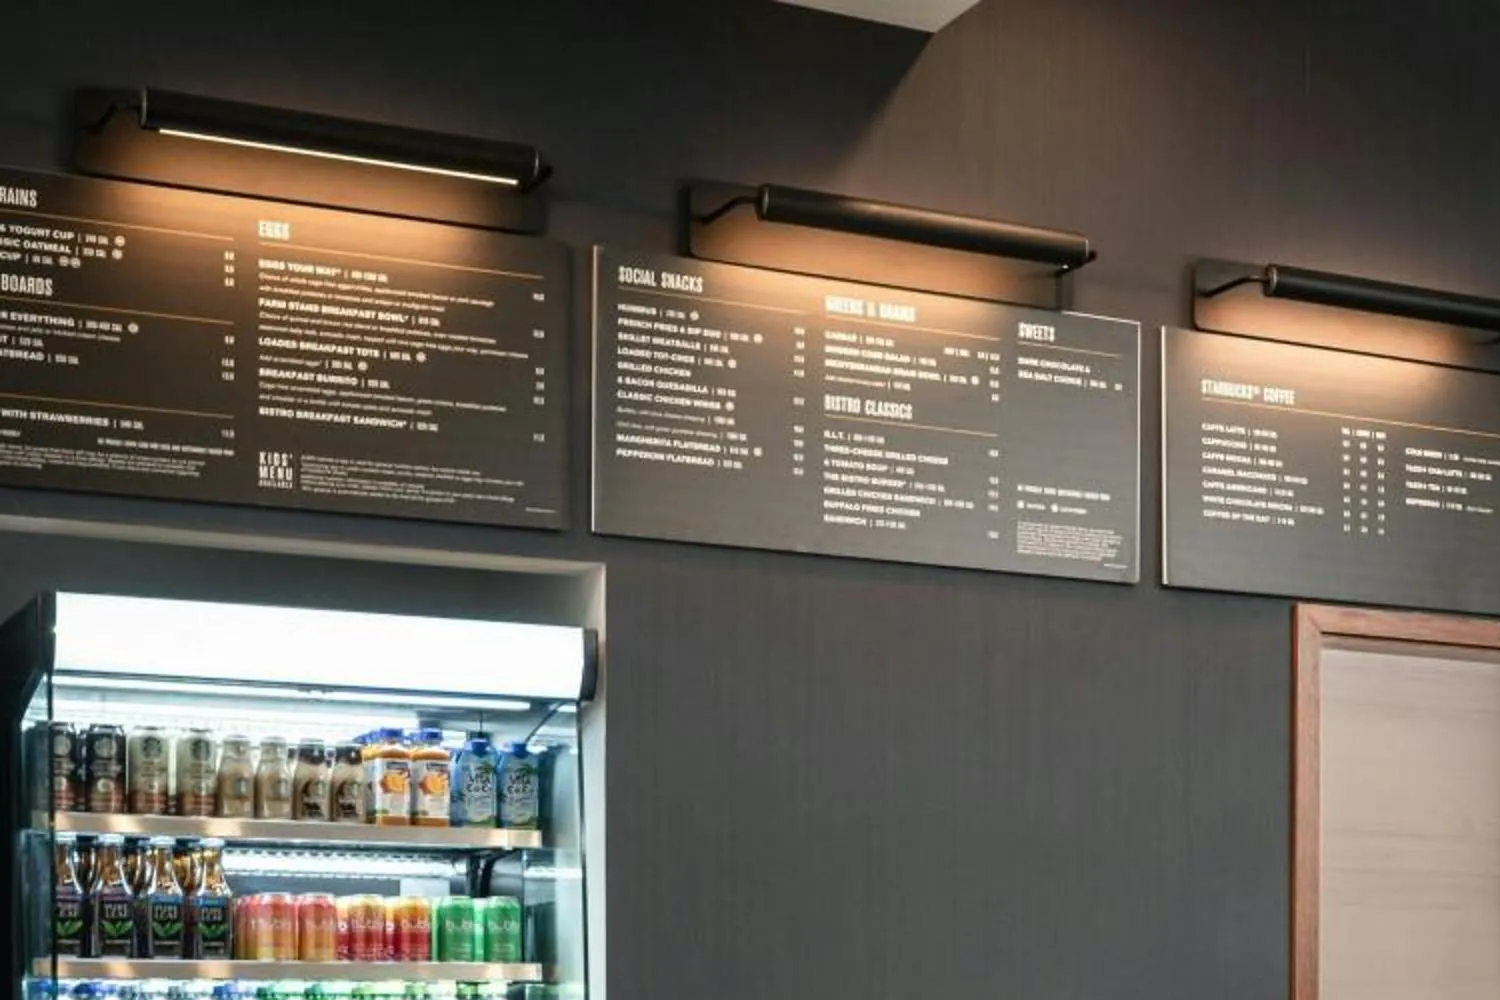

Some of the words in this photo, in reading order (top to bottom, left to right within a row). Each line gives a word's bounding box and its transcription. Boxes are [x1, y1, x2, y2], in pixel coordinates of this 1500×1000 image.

[9, 225, 51, 238] YOGURT
[52, 230, 75, 240] CUP
[23, 240, 72, 254] OATMEAL
[1, 274, 53, 297] BOARDS
[618, 266, 658, 287] SOCIAL
[660, 271, 704, 293] SNACKS
[321, 305, 377, 319] BREAKFAST
[10, 313, 75, 327] EVERYTHING
[618, 318, 653, 330] FRENCH
[1018, 322, 1056, 342] SWEETS
[259, 337, 299, 349] LOADED
[300, 341, 355, 355] BREAKFAST
[652, 337, 701, 351] MEATBALLS
[618, 346, 653, 359] LOADED
[259, 368, 315, 381] BREAKFAST
[1263, 387, 1296, 405] COFFEE
[864, 398, 914, 420] CLASSICS
[30, 412, 110, 427] STRAWBERRIES
[296, 410, 352, 424] BREAKFAST
[259, 466, 293, 481] MENU
